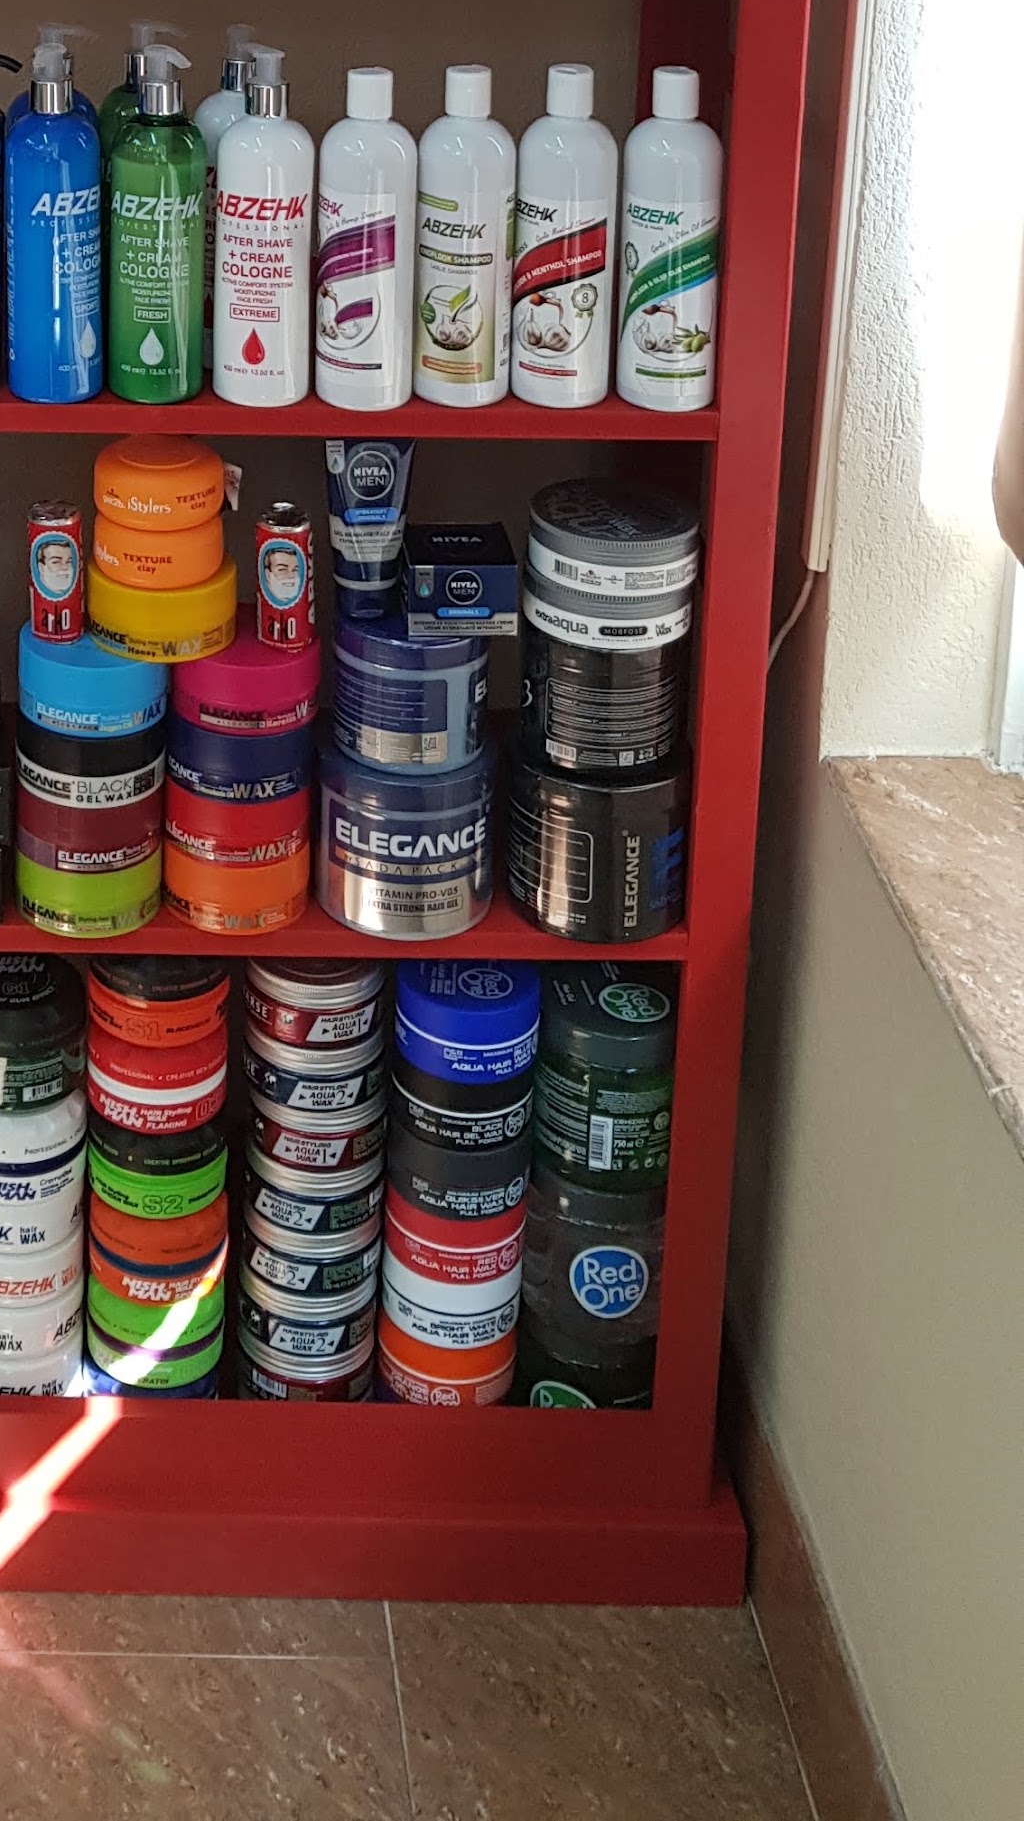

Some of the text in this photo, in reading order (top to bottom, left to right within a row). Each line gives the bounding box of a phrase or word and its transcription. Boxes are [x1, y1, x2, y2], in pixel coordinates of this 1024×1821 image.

[111, 191, 203, 221] ABZEHK
[217, 191, 308, 221] ABZEHK
[627, 203, 684, 225] ABZEHK
[422, 216, 486, 240] ABZEHK
[55, 232, 87, 244] AFTER
[120, 234, 189, 247] AFTER SHAVE
[223, 234, 293, 248] AFTER SHAVE
[138, 252, 182, 264] CREAM
[240, 252, 284, 263] CREAM
[453, 253, 493, 264] SHAMPOO
[566, 249, 603, 266] SHAMPOO
[120, 262, 189, 279] COLOGNE
[222, 262, 293, 278] COLOGNE
[137, 310, 168, 320] FRESH
[233, 308, 277, 319] EXTREME
[353, 466, 389, 477] NIVEA
[356, 476, 385, 487] MEN
[127, 485, 217, 515] iStylers TEXTURE
[431, 535, 483, 544] NIVEA
[122, 553, 173, 564] TEXTURE
[137, 564, 157, 575] clay
[450, 581, 478, 589] NIVEA
[452, 588, 475, 596] MEN
[127, 638, 204, 657] Honey WAX
[36, 701, 101, 725] ELEGANCE
[77, 777, 132, 795] BLACK
[232, 780, 277, 799] WAX
[76, 790, 133, 803] GEL WAX
[335, 816, 486, 858] ELEGANCE
[58, 849, 124, 864] ELEGANCE
[250, 839, 288, 862] WAX
[623, 835, 641, 927] ELEGANCE
[331, 1019, 357, 1032] AQUA
[451, 1059, 512, 1072] AQUA HAIR
[309, 1090, 336, 1100] AQUA
[146, 1119, 188, 1130] FLAMING
[414, 1119, 461, 1138] AQUA HAIR
[472, 1123, 503, 1133] BLACK
[294, 1144, 321, 1157] AQUA
[142, 1194, 183, 1215] S2
[418, 1193, 477, 1211] AQUA HAIR
[19, 1231, 46, 1245] WAX
[410, 1254, 497, 1274] AQUA HAIR WAX
[582, 1257, 637, 1285] Red
[579, 1283, 641, 1311] One
[411, 1323, 496, 1339] AQUA HAIR WAX
[430, 1319, 496, 1332] BRIGHT WHITE
[289, 1336, 316, 1346] AQUA
